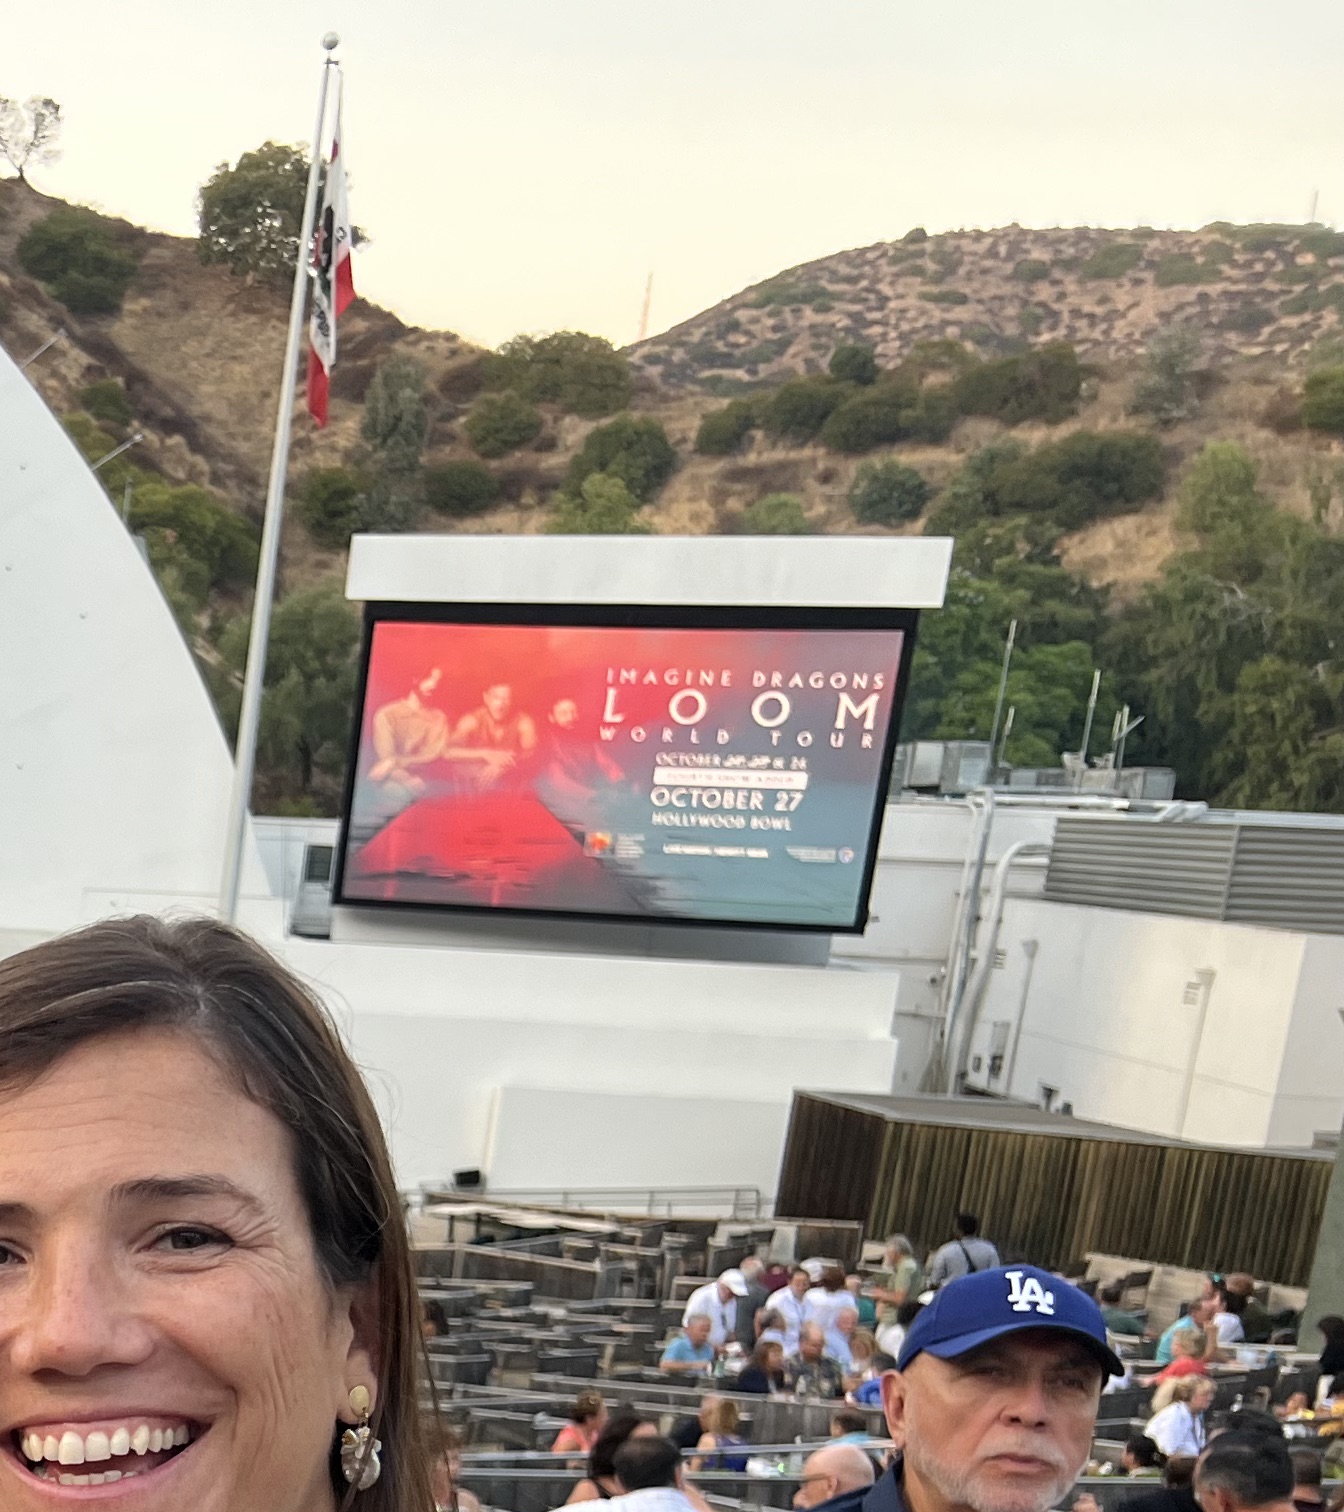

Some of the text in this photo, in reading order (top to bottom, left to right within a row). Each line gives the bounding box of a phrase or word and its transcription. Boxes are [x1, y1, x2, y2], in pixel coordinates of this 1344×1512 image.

[606, 668, 885, 690] IMAGINE DRAGONS
[603, 686, 880, 730] LOOM
[599, 726, 873, 749] WORLD TOUR
[650, 786, 804, 812] OCTOBER 27
[651, 811, 792, 831] HOLLYWOOD BOWL
[1005, 1270, 1055, 1316] LA
